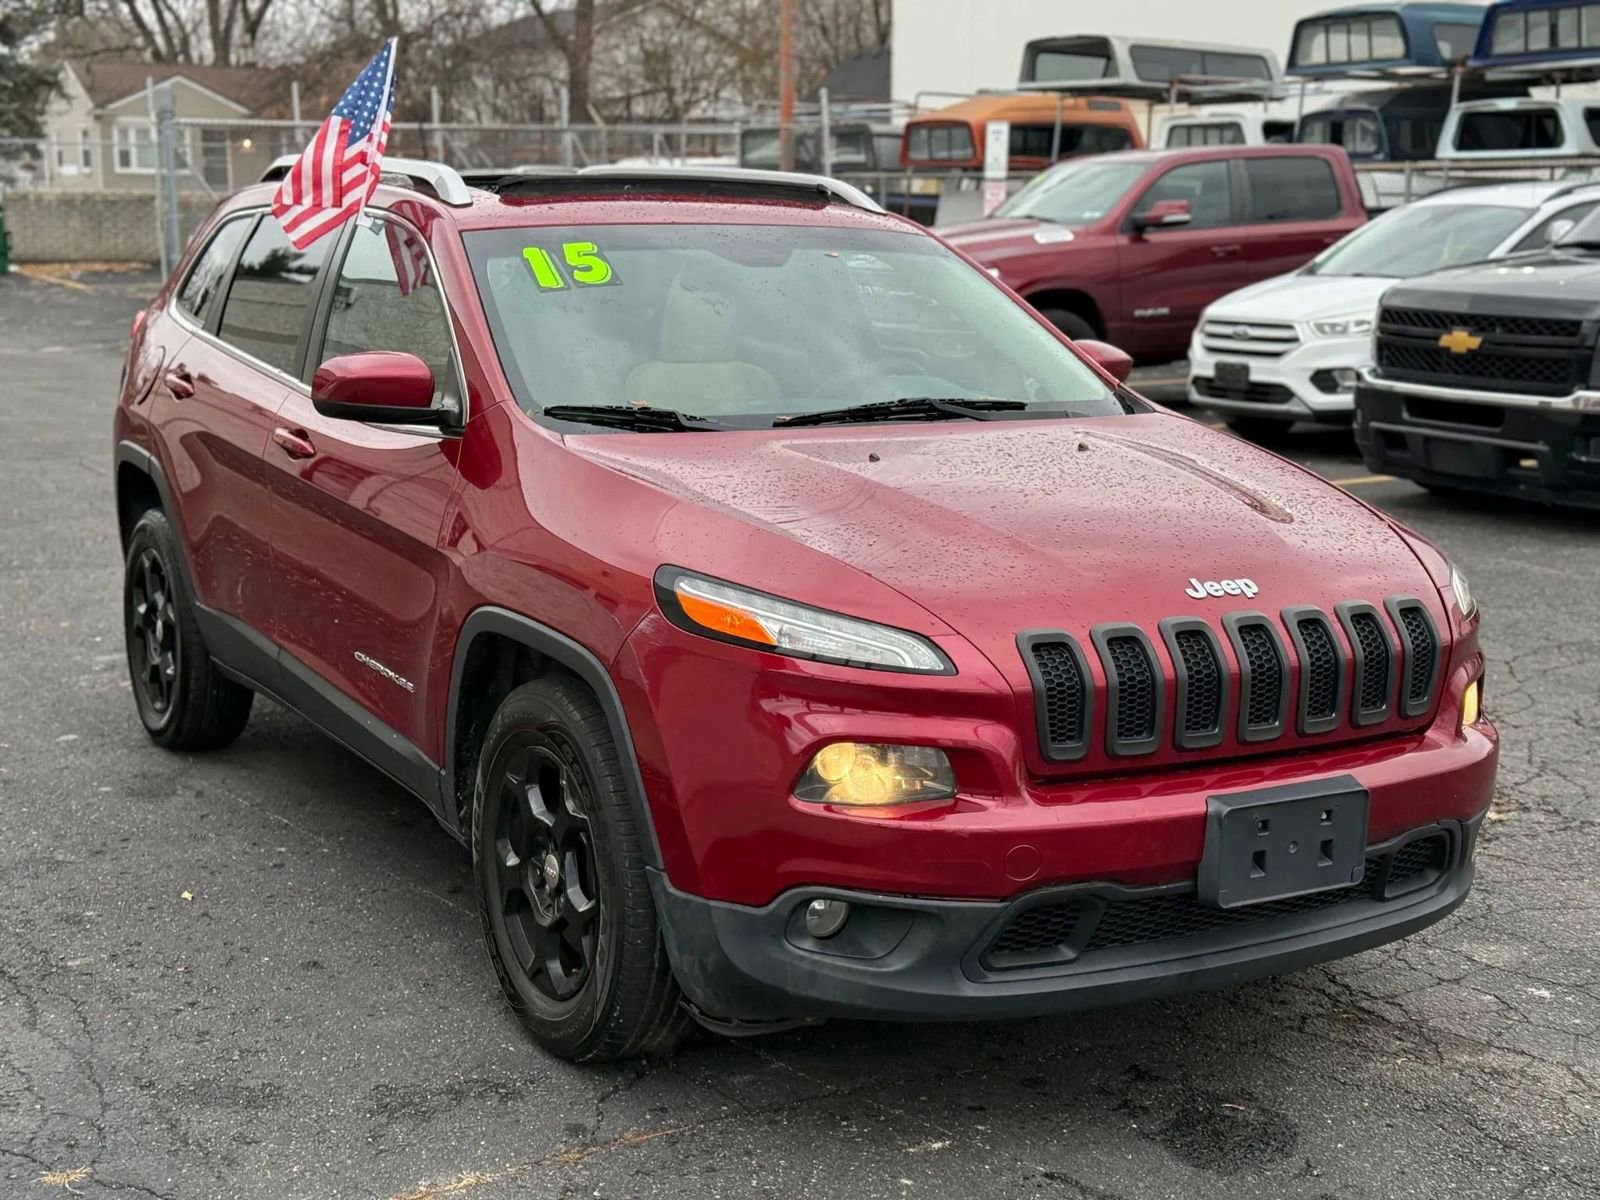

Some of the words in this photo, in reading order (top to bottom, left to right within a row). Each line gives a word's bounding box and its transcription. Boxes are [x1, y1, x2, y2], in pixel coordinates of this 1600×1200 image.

[522, 241, 612, 289] 15
[1184, 577, 1259, 600] Jeep
[353, 651, 416, 693] CHEROKEE
